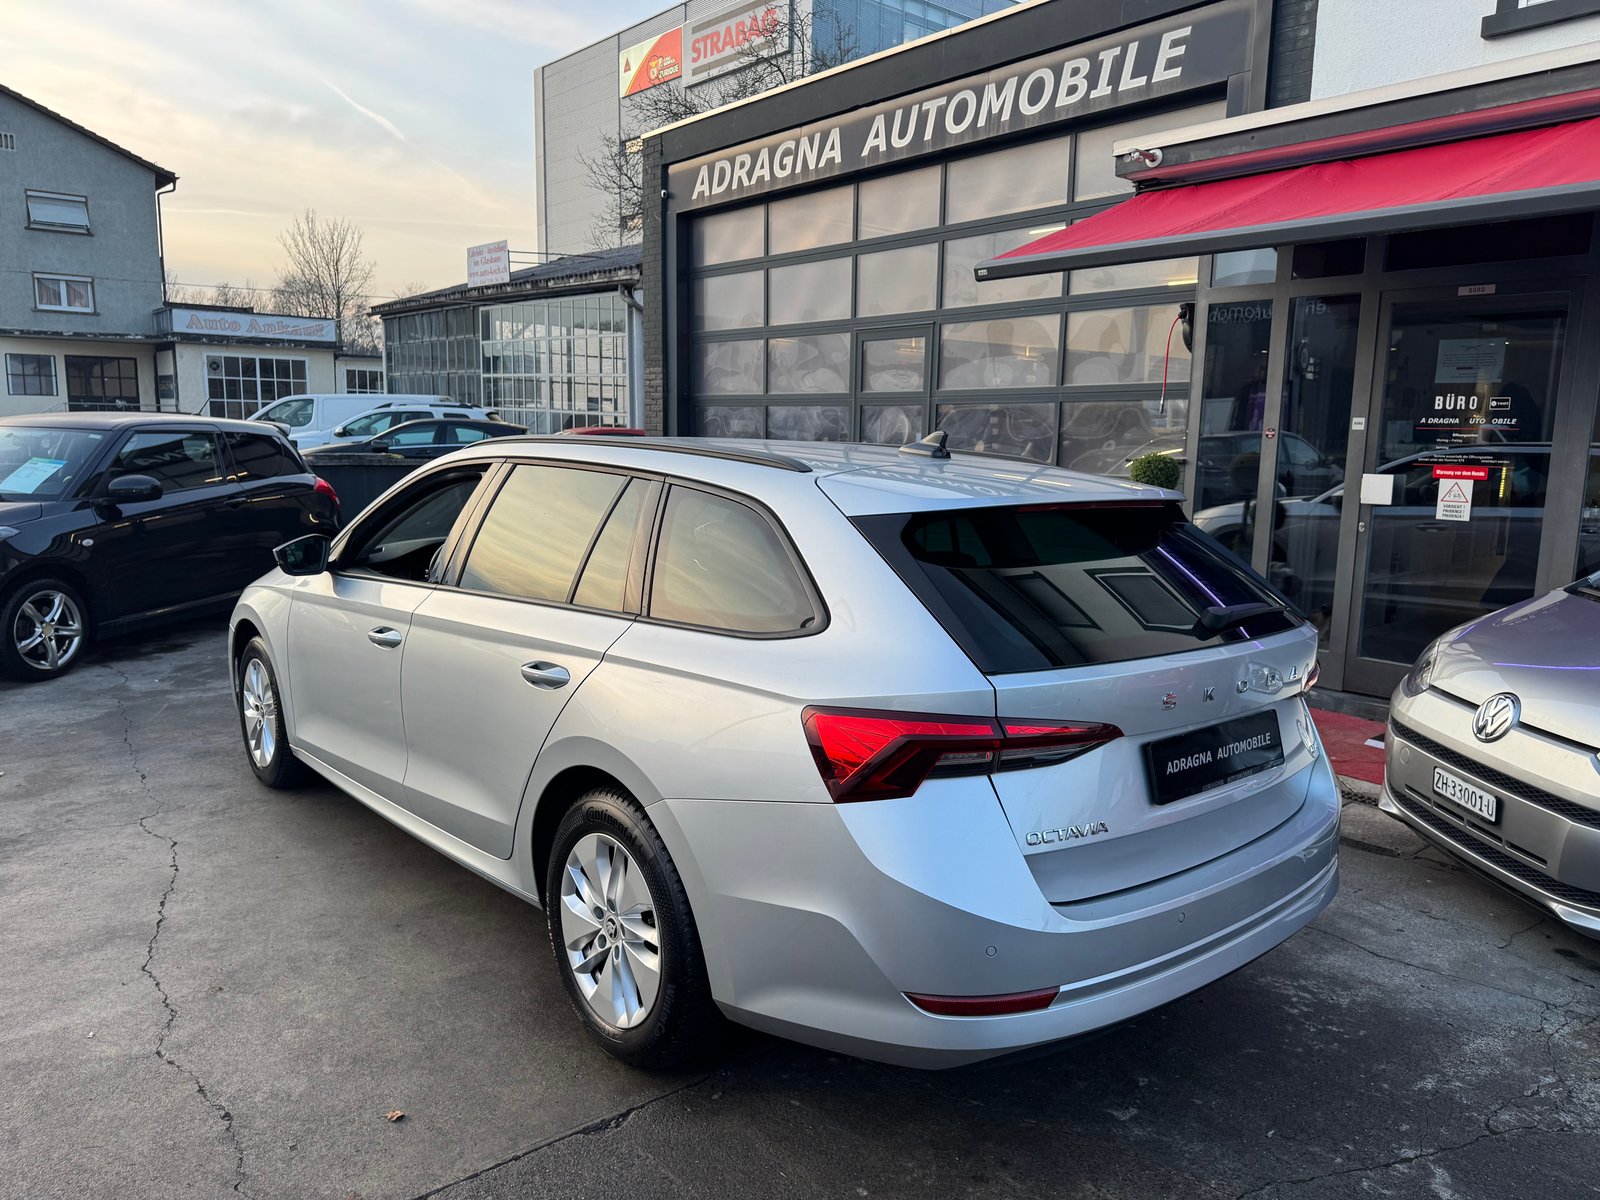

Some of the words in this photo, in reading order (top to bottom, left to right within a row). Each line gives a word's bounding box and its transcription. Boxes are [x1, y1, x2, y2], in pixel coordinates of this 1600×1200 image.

[691, 8, 778, 63] STRABAG
[691, 127, 842, 199] ADRAGNA
[861, 26, 1192, 157] AUTOMOBILE
[186, 314, 241, 332] Auto
[246, 319, 325, 337] Ankauf
[1434, 394, 1478, 410] BÜRO
[1166, 750, 1213, 775] ADRAGNA
[1217, 732, 1272, 760] AUTOMOBILE
[586, 806, 638, 846] Continental
[1025, 820, 1109, 846] OCTAVIA
